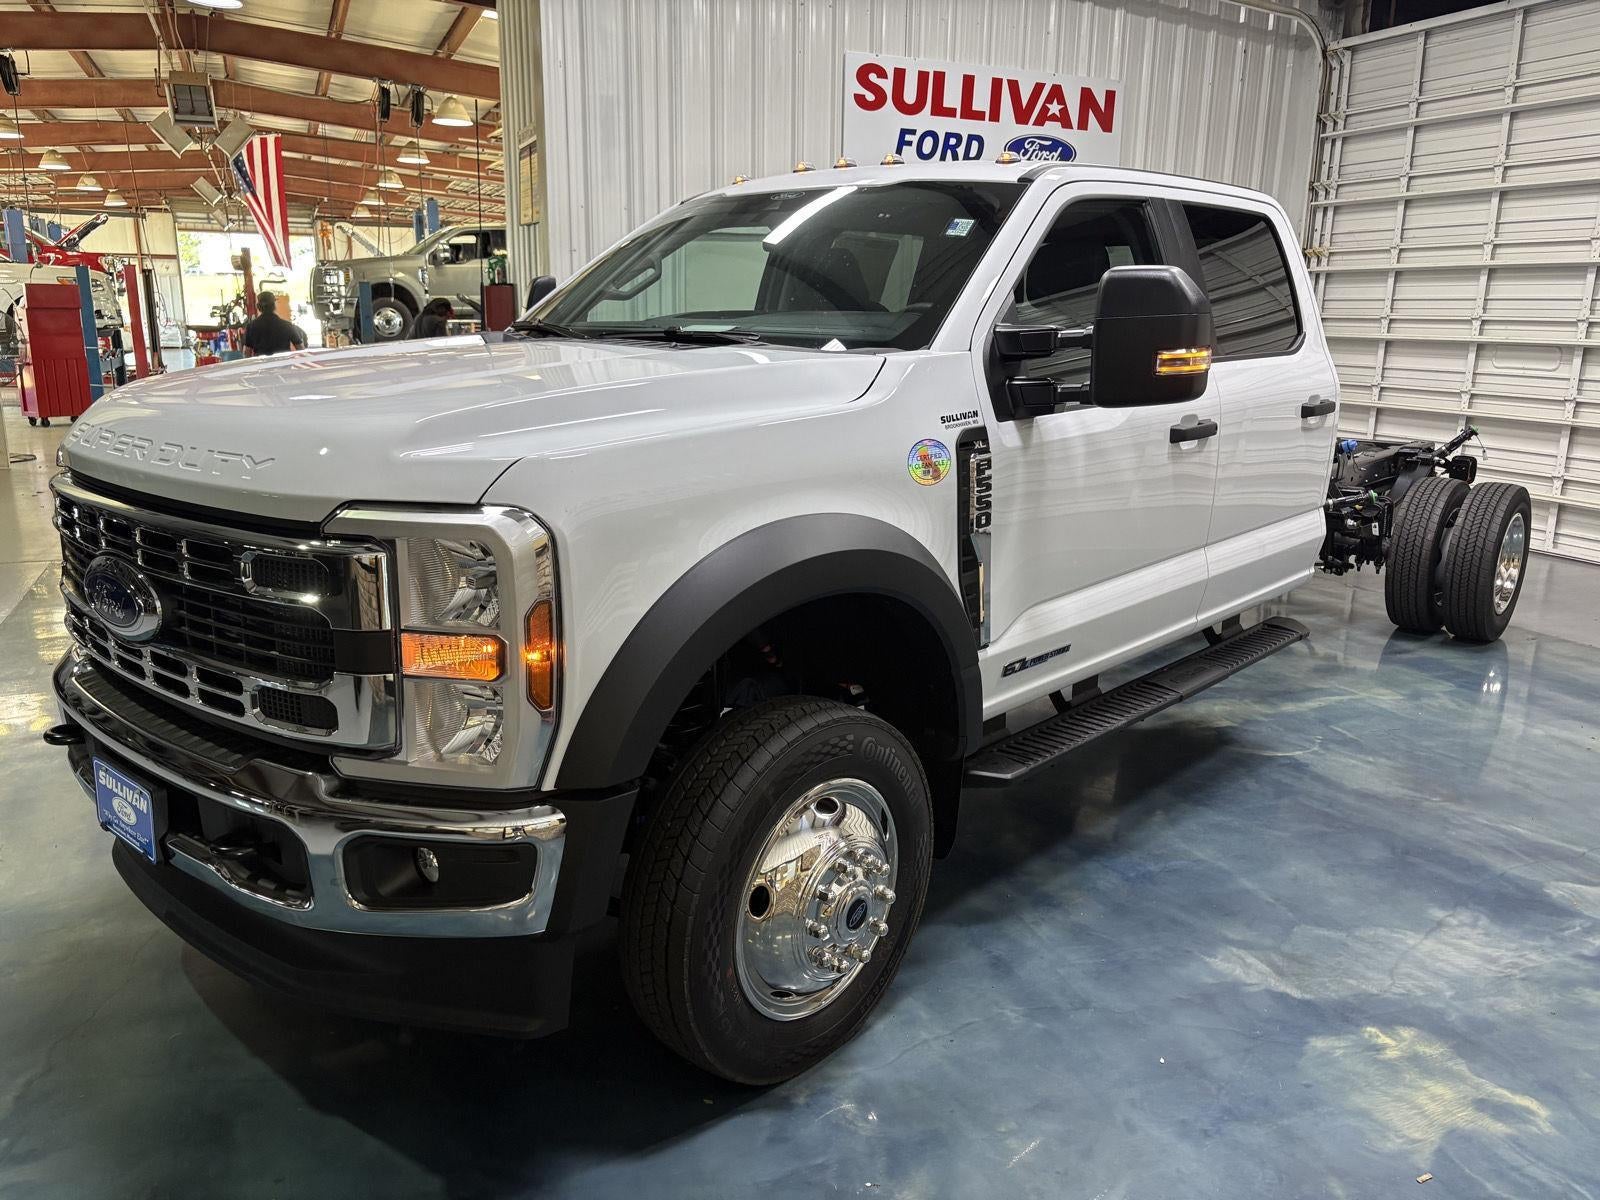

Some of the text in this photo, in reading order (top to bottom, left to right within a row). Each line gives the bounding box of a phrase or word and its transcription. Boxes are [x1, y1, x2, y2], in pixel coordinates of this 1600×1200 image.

[853, 62, 1116, 133] SULLIVAN
[895, 127, 985, 161] FORD
[1020, 138, 1063, 161] Ford
[940, 409, 979, 424] SULLIVAN
[69, 422, 276, 479] SUPER DUTY
[973, 440, 987, 449] XL
[98, 768, 148, 814] SULLIVAN
